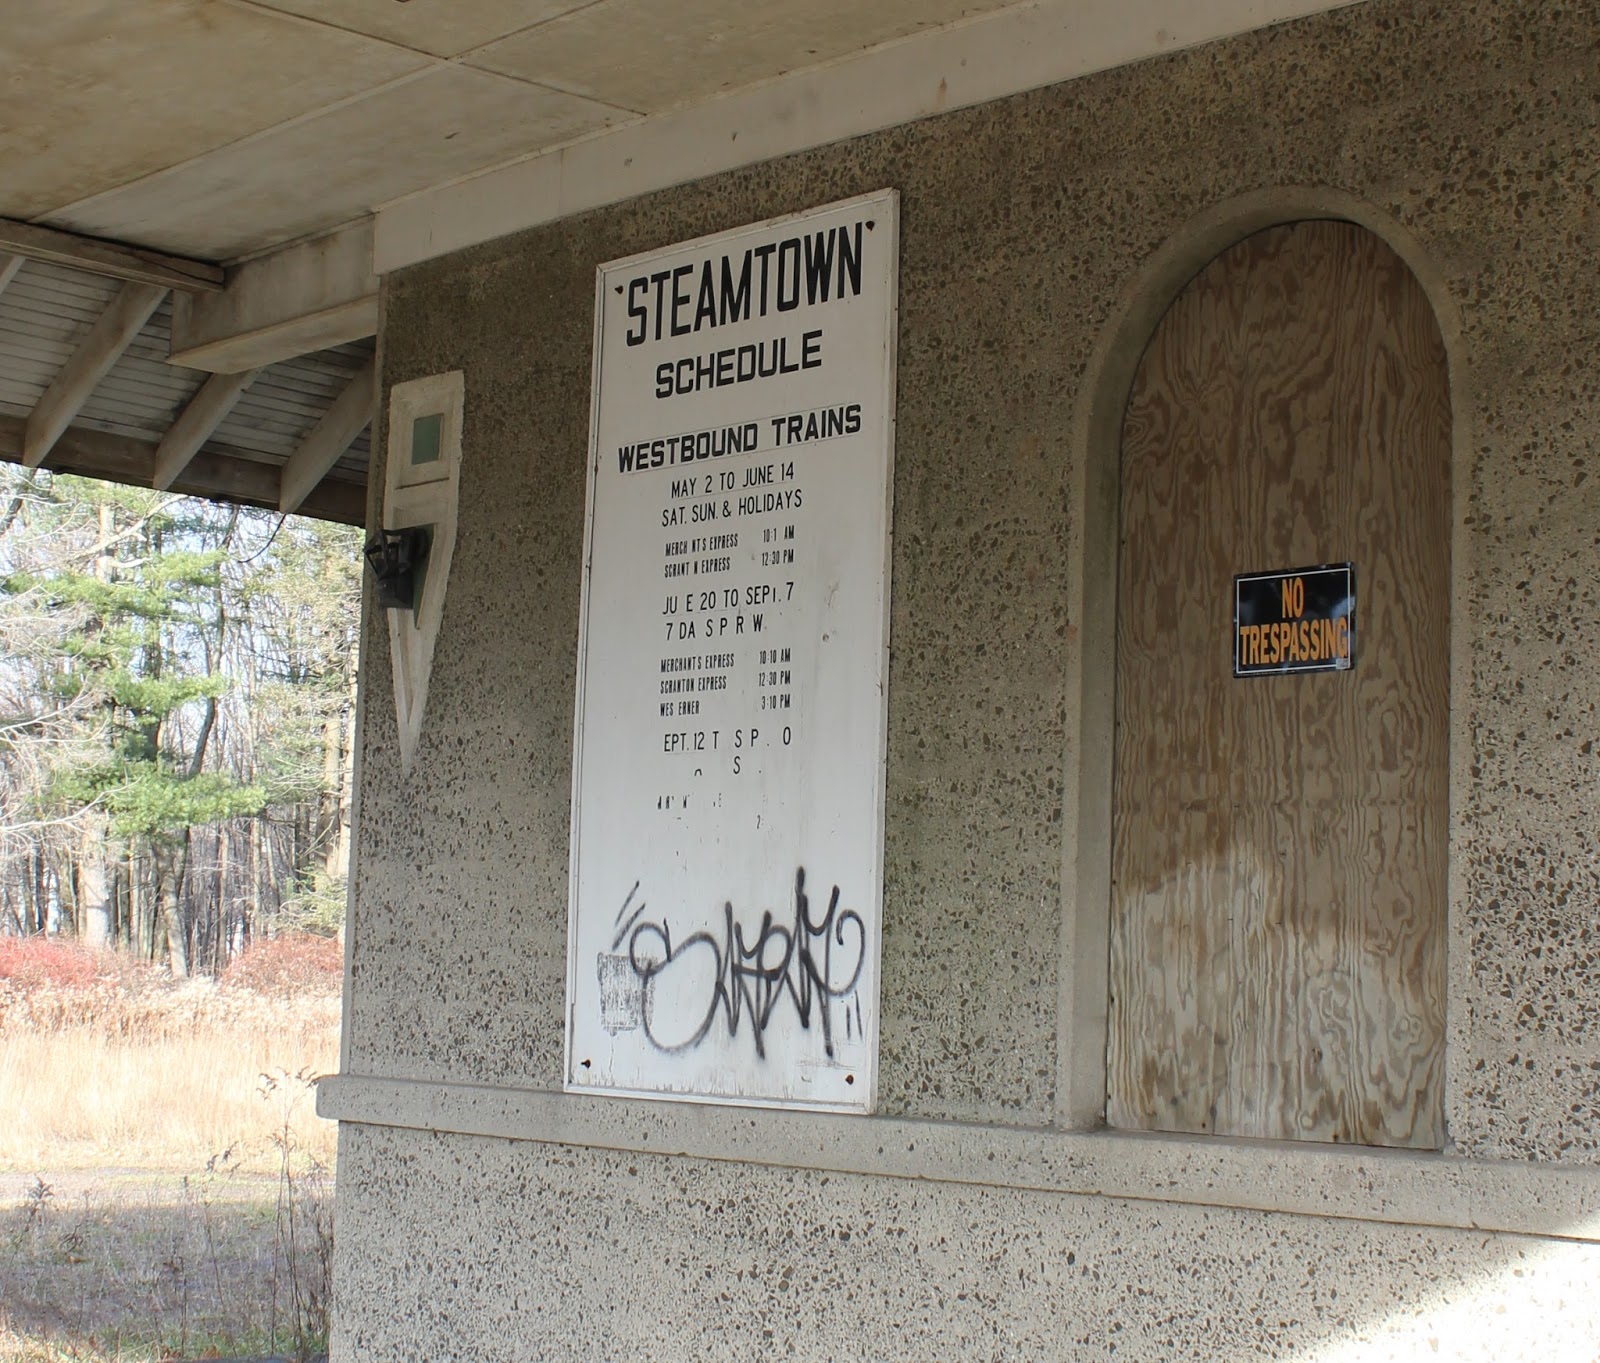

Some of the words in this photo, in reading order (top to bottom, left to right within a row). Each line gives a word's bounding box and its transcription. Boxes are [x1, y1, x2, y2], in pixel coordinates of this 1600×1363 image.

[626, 221, 862, 347] STEAMTOWN
[655, 329, 823, 399] SCHEDULE
[618, 423, 758, 473] WESTBOUND
[771, 404, 861, 446] TRAINS
[671, 477, 697, 499] MAY
[704, 475, 713, 494] 2
[719, 471, 735, 491] TO
[742, 464, 774, 488] JUNE
[780, 461, 794, 481] 14
[661, 506, 687, 527] SAT.
[691, 502, 718, 523] SUN.
[722, 500, 731, 518] &
[738, 488, 802, 516] HOLIDAYS
[709, 532, 738, 551] EXPRESS
[763, 527, 778, 543] 10:1
[783, 524, 795, 540] AM
[664, 560, 698, 578] SCRANTN
[701, 556, 731, 574] EXPRESS
[762, 550, 780, 566] 12:30
[783, 548, 794, 564] PM
[662, 593, 694, 615] JUE
[700, 590, 717, 611] 20
[723, 588, 739, 608] TO
[786, 581, 794, 601] 7
[1281, 577, 1304, 619] NO
[666, 622, 673, 641] 7
[679, 618, 714, 640] DAS
[719, 615, 744, 636] PR
[1239, 616, 1348, 666] TRESPASSING
[705, 652, 735, 669] EXPRESS
[759, 649, 777, 665] 10:10
[780, 647, 791, 663] AM
[660, 678, 695, 694] SCRANTON
[698, 675, 727, 692] EXPRESS
[759, 671, 777, 687] 12:30
[780, 670, 791, 685] PM
[660, 700, 700, 717] WESERNER
[761, 694, 777, 710] 3:10
[780, 693, 791, 709] PM
[664, 732, 690, 752] EPT.
